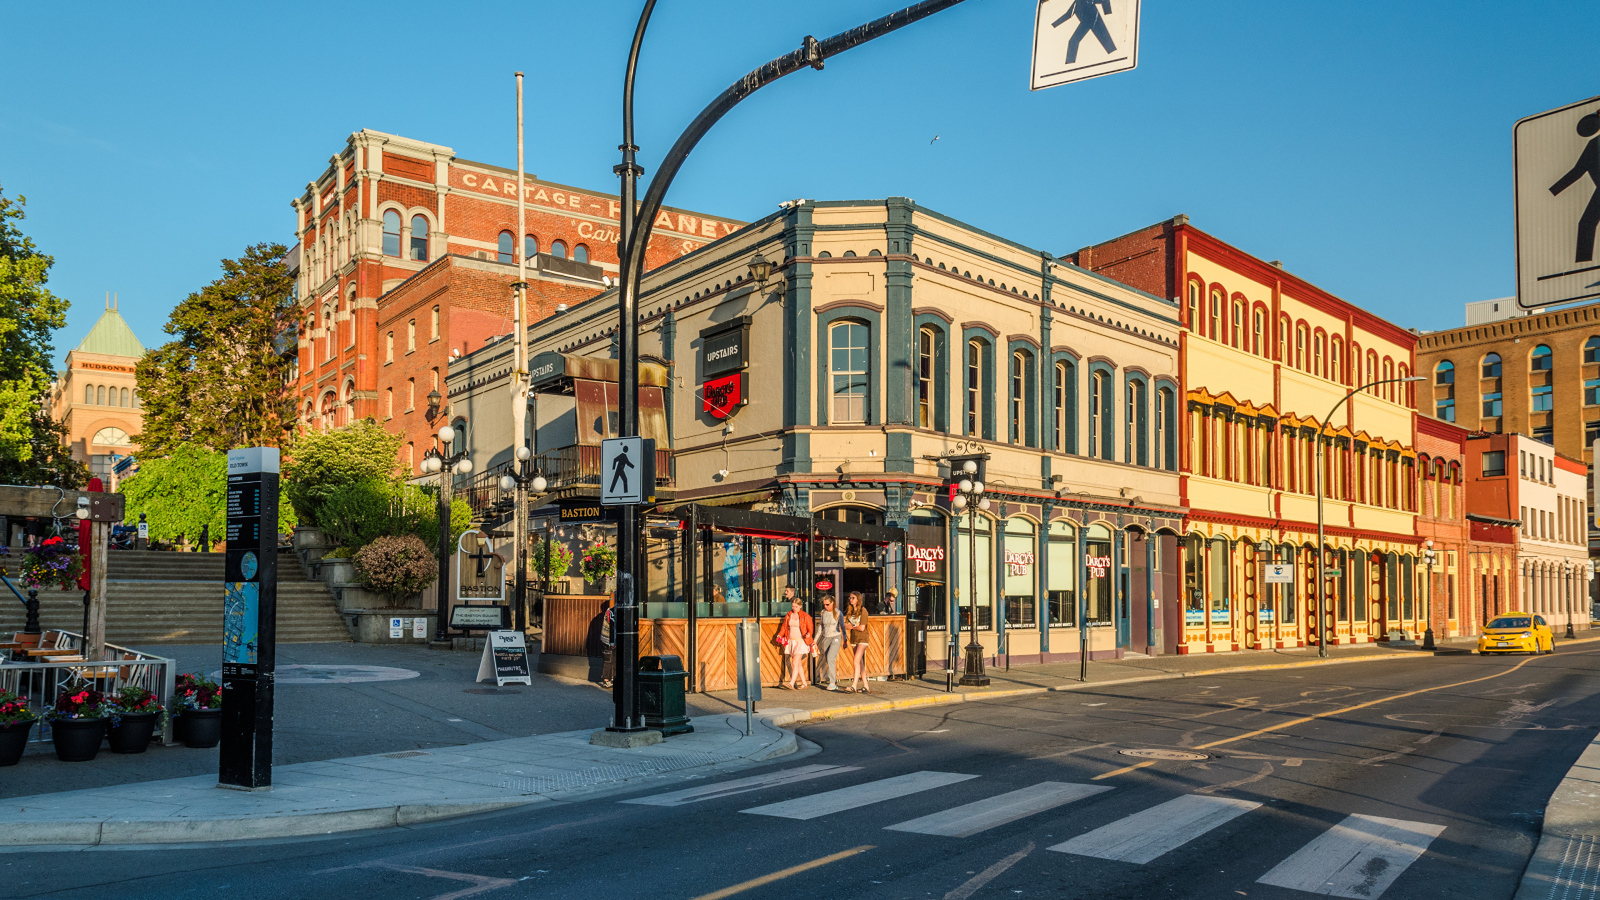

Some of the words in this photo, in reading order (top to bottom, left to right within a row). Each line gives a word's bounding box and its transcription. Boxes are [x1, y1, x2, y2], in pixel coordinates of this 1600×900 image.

[463, 174, 581, 208] CARTAGE
[609, 201, 739, 238] HANEY
[707, 345, 738, 362] UPSTAIRS
[82, 362, 126, 372] HUDSON'S
[562, 507, 600, 518] BASTION
[907, 544, 944, 560] DARCY'S
[1005, 550, 1034, 564] DARCY'S
[915, 559, 936, 574] PUB
[1085, 553, 1111, 568] DARCY'S
[1011, 563, 1028, 576] PUB
[1091, 566, 1105, 579] PUB
